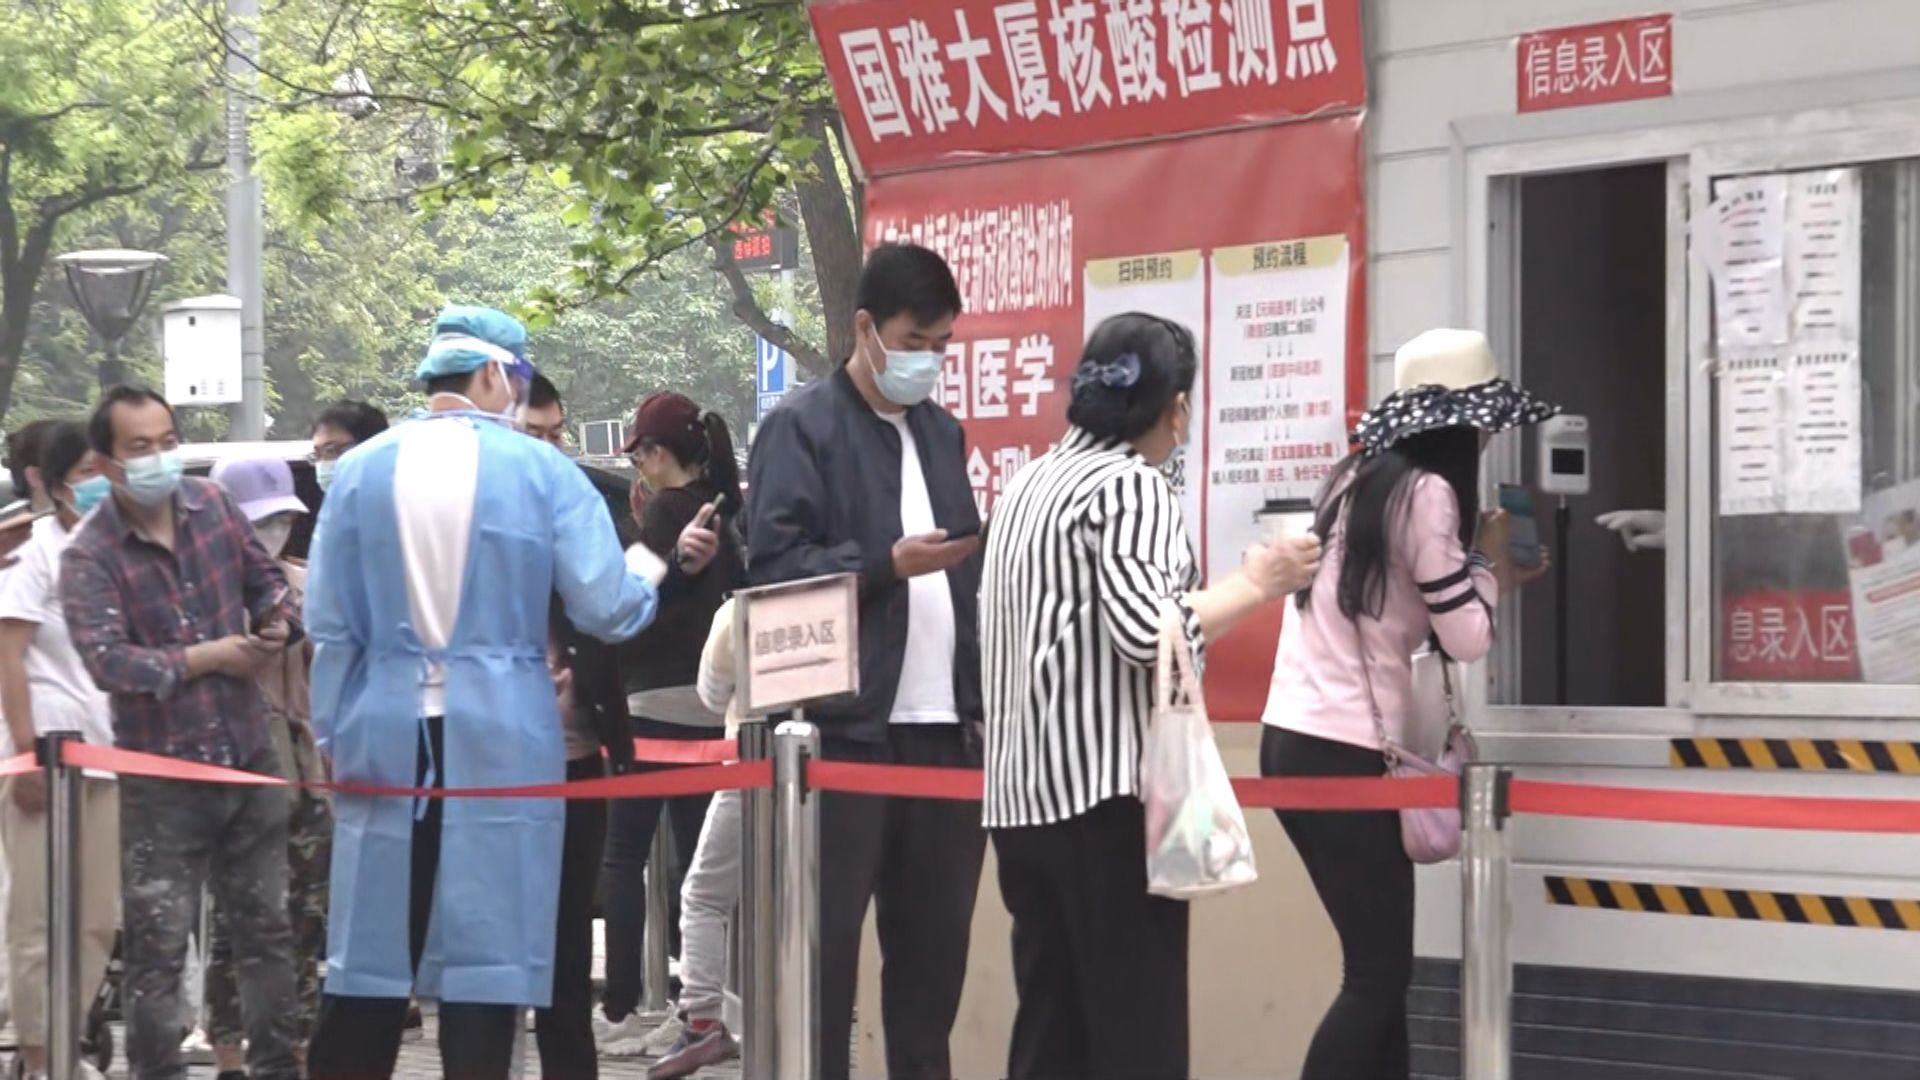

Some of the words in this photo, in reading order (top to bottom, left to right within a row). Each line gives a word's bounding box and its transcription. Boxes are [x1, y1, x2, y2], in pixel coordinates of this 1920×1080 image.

[839, 0, 1338, 142] 国雅大厦核酸检测点
[1525, 27, 1667, 99] 信息录入区
[1118, 257, 1173, 283] 扫码预约
[1253, 241, 1307, 271] 预约流程
[755, 619, 836, 656] 信息录入区
[1730, 604, 1850, 662] 息录入区
